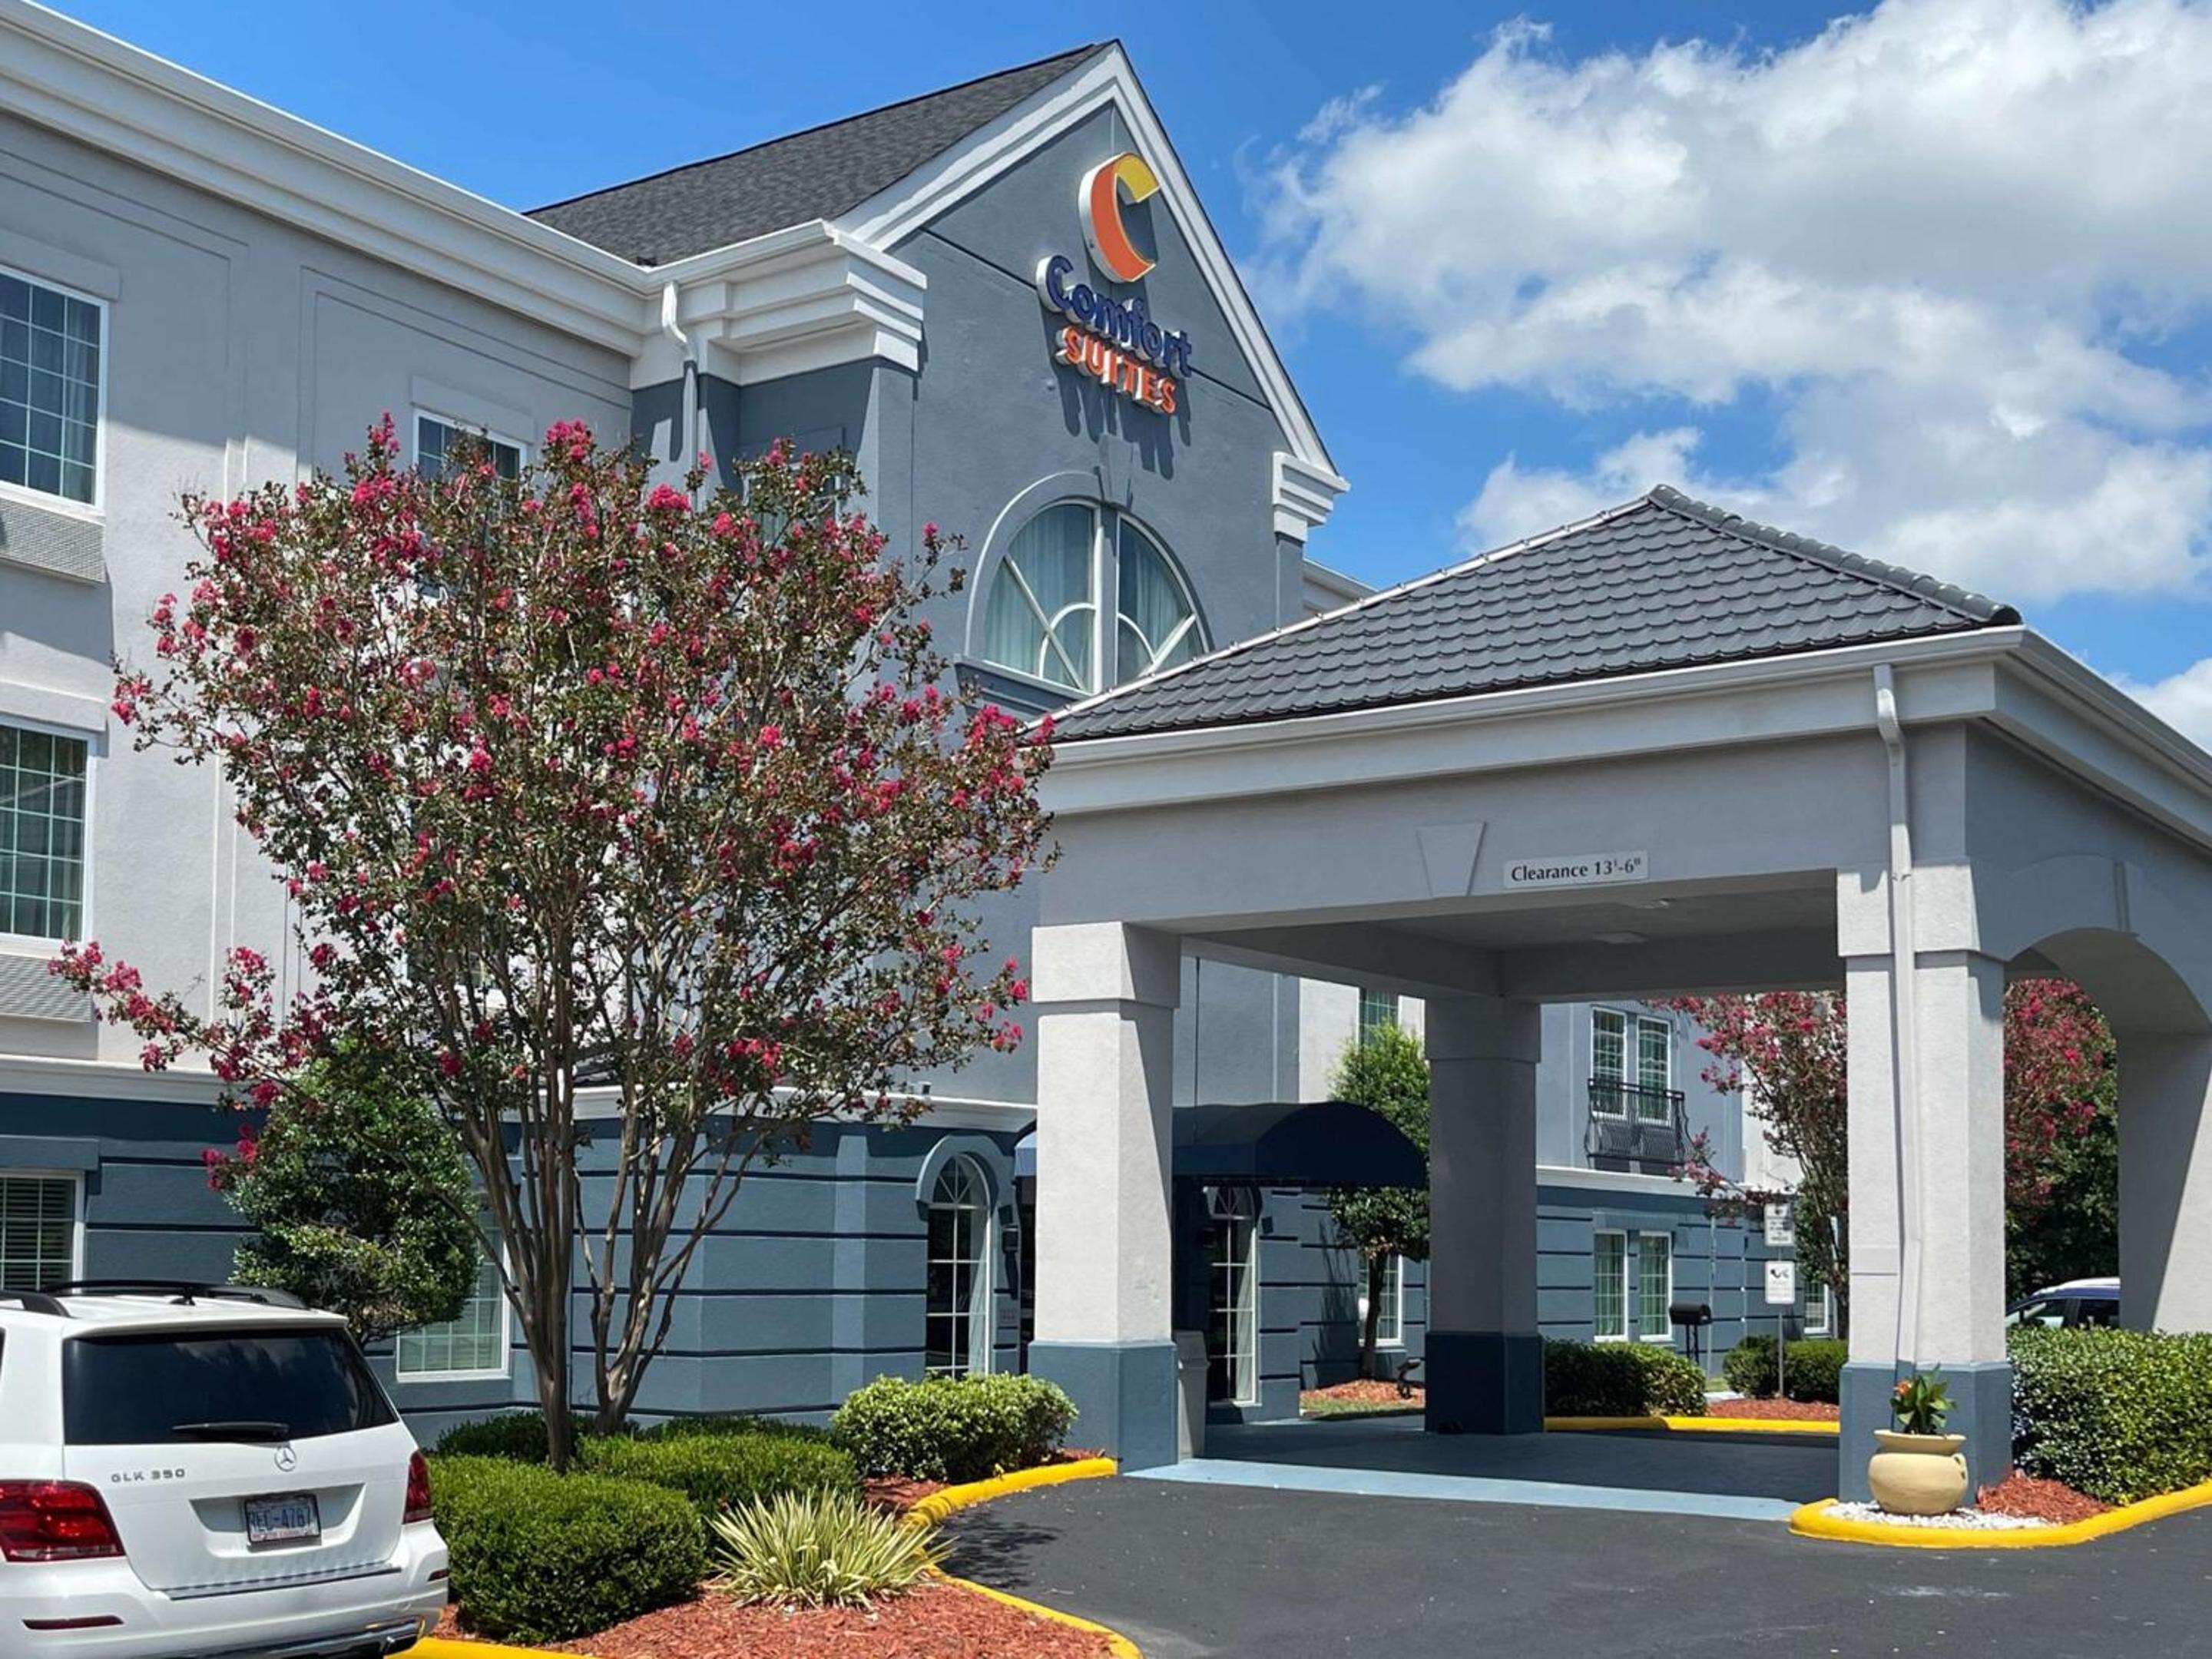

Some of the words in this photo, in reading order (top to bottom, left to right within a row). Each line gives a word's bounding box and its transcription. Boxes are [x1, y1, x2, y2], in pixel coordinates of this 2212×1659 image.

[1038, 254, 1192, 378] Comfort
[1056, 326, 1176, 414] SUITES
[1511, 865, 1588, 882] Clearance
[1594, 856, 1641, 876] 13'-6"
[111, 1471, 145, 1483] GLK
[151, 1468, 185, 1481] 350
